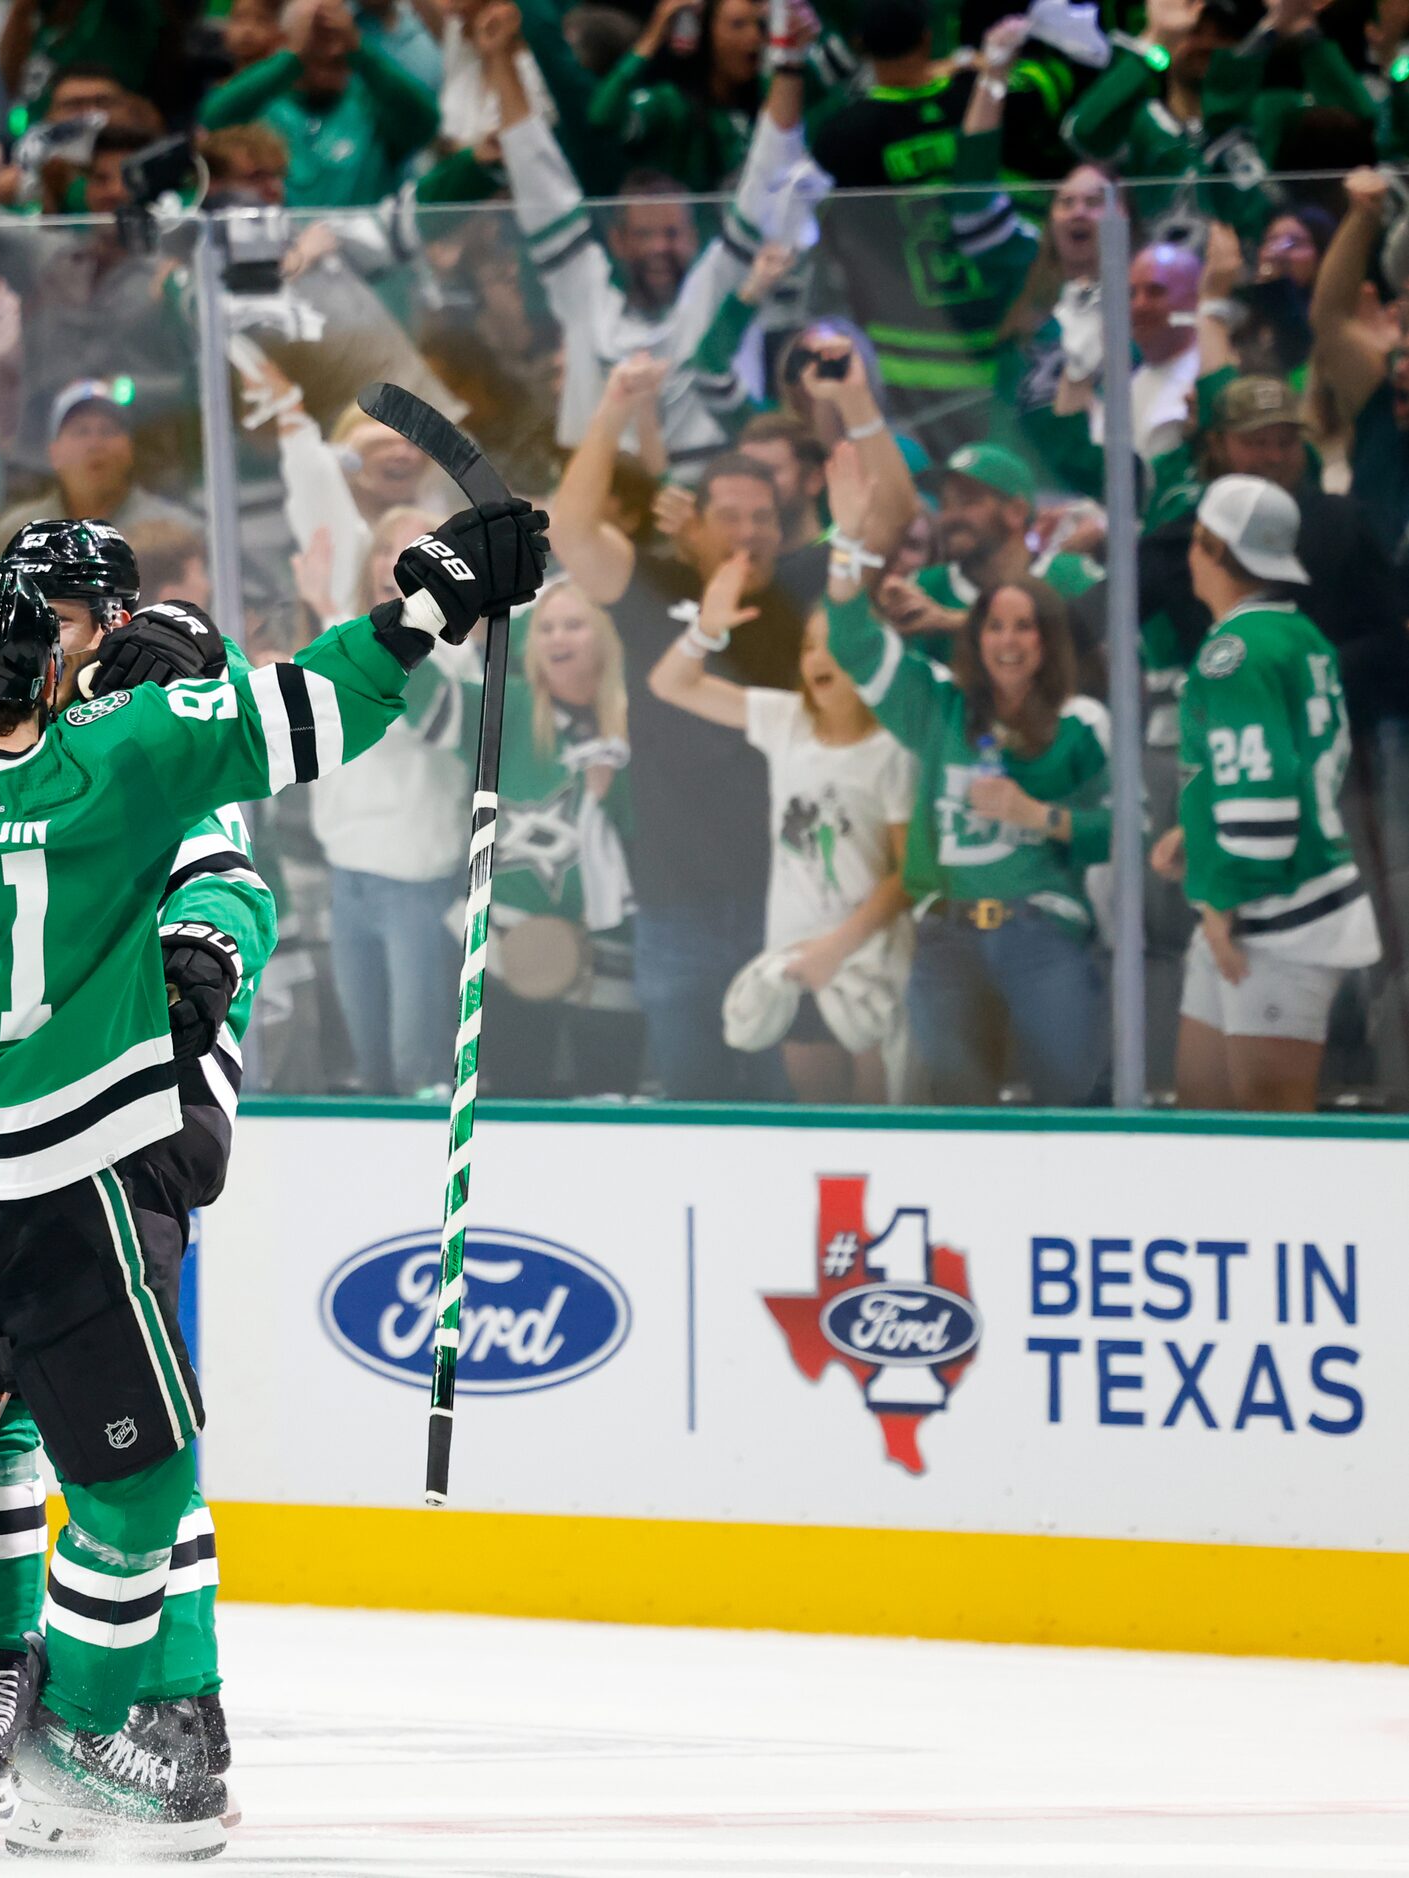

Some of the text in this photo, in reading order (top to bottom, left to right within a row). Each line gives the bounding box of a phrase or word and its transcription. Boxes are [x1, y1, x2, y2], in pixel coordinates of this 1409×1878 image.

[21, 533, 50, 549] 23
[164, 678, 238, 721] 91
[1206, 723, 1274, 786] 24
[1028, 1235, 1359, 1325] BEST IN
[849, 1289, 952, 1355] Ford
[1026, 1337, 1365, 1436] TEXAS
[114, 1425, 130, 1444] NHL
